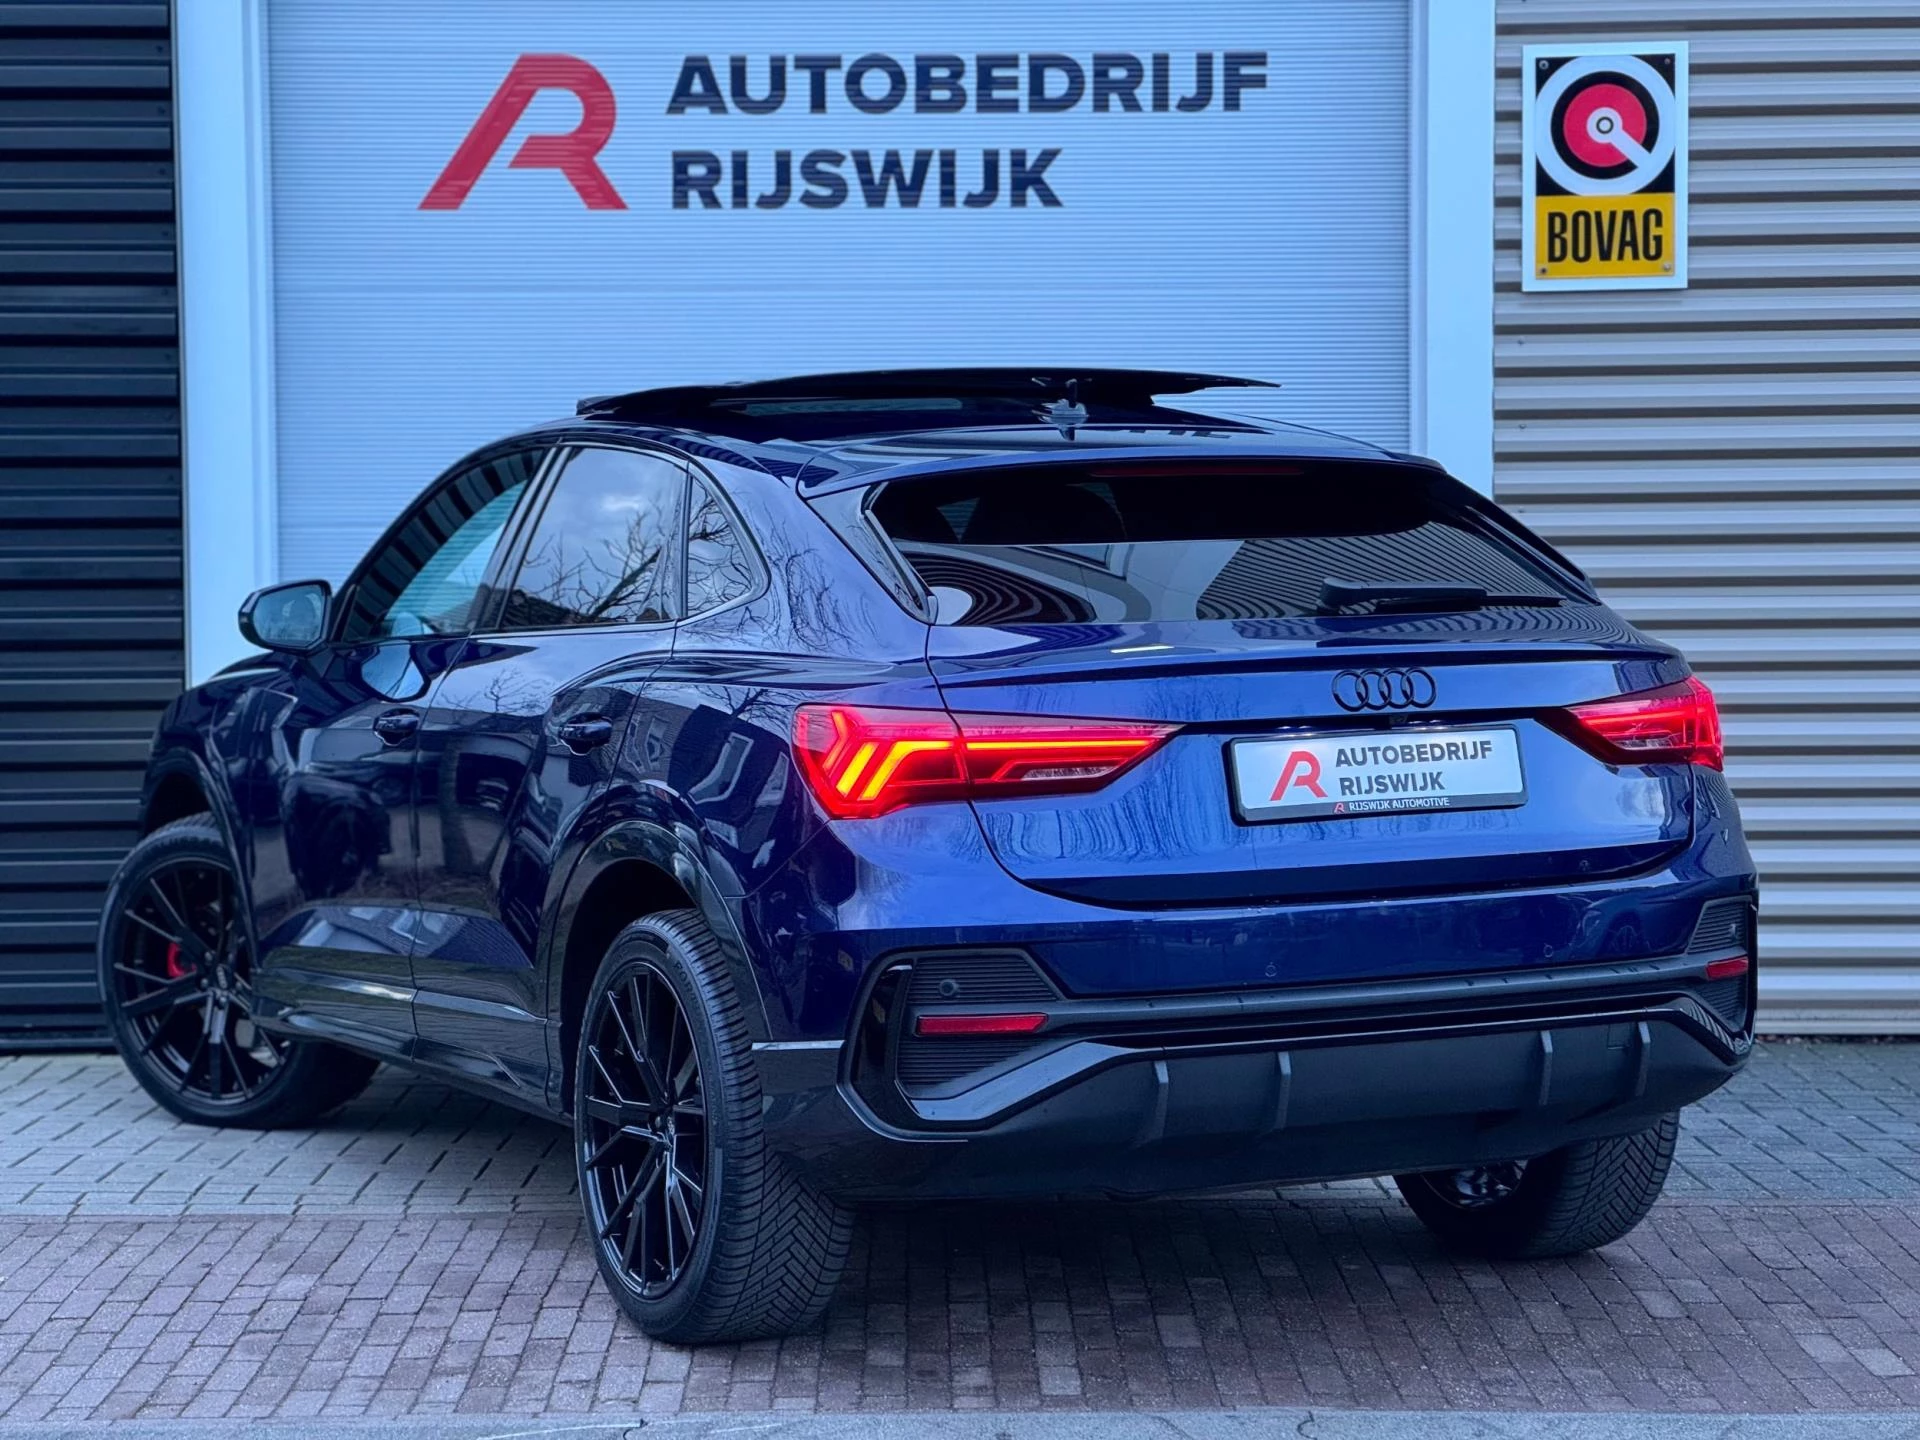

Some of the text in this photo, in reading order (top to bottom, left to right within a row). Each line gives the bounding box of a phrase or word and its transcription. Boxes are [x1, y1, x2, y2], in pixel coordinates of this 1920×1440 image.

[666, 52, 1267, 114] AUTOBEDRIJF
[671, 149, 1063, 208] RIJSWIJK
[1548, 208, 1663, 263] BOVAG
[1335, 740, 1492, 767] AUTOBEDRIJF
[1339, 772, 1446, 796] RIJSWIJK
[1349, 800, 1390, 811] RIJSWIJK
[1392, 797, 1450, 809] AUTOMOTIVE
